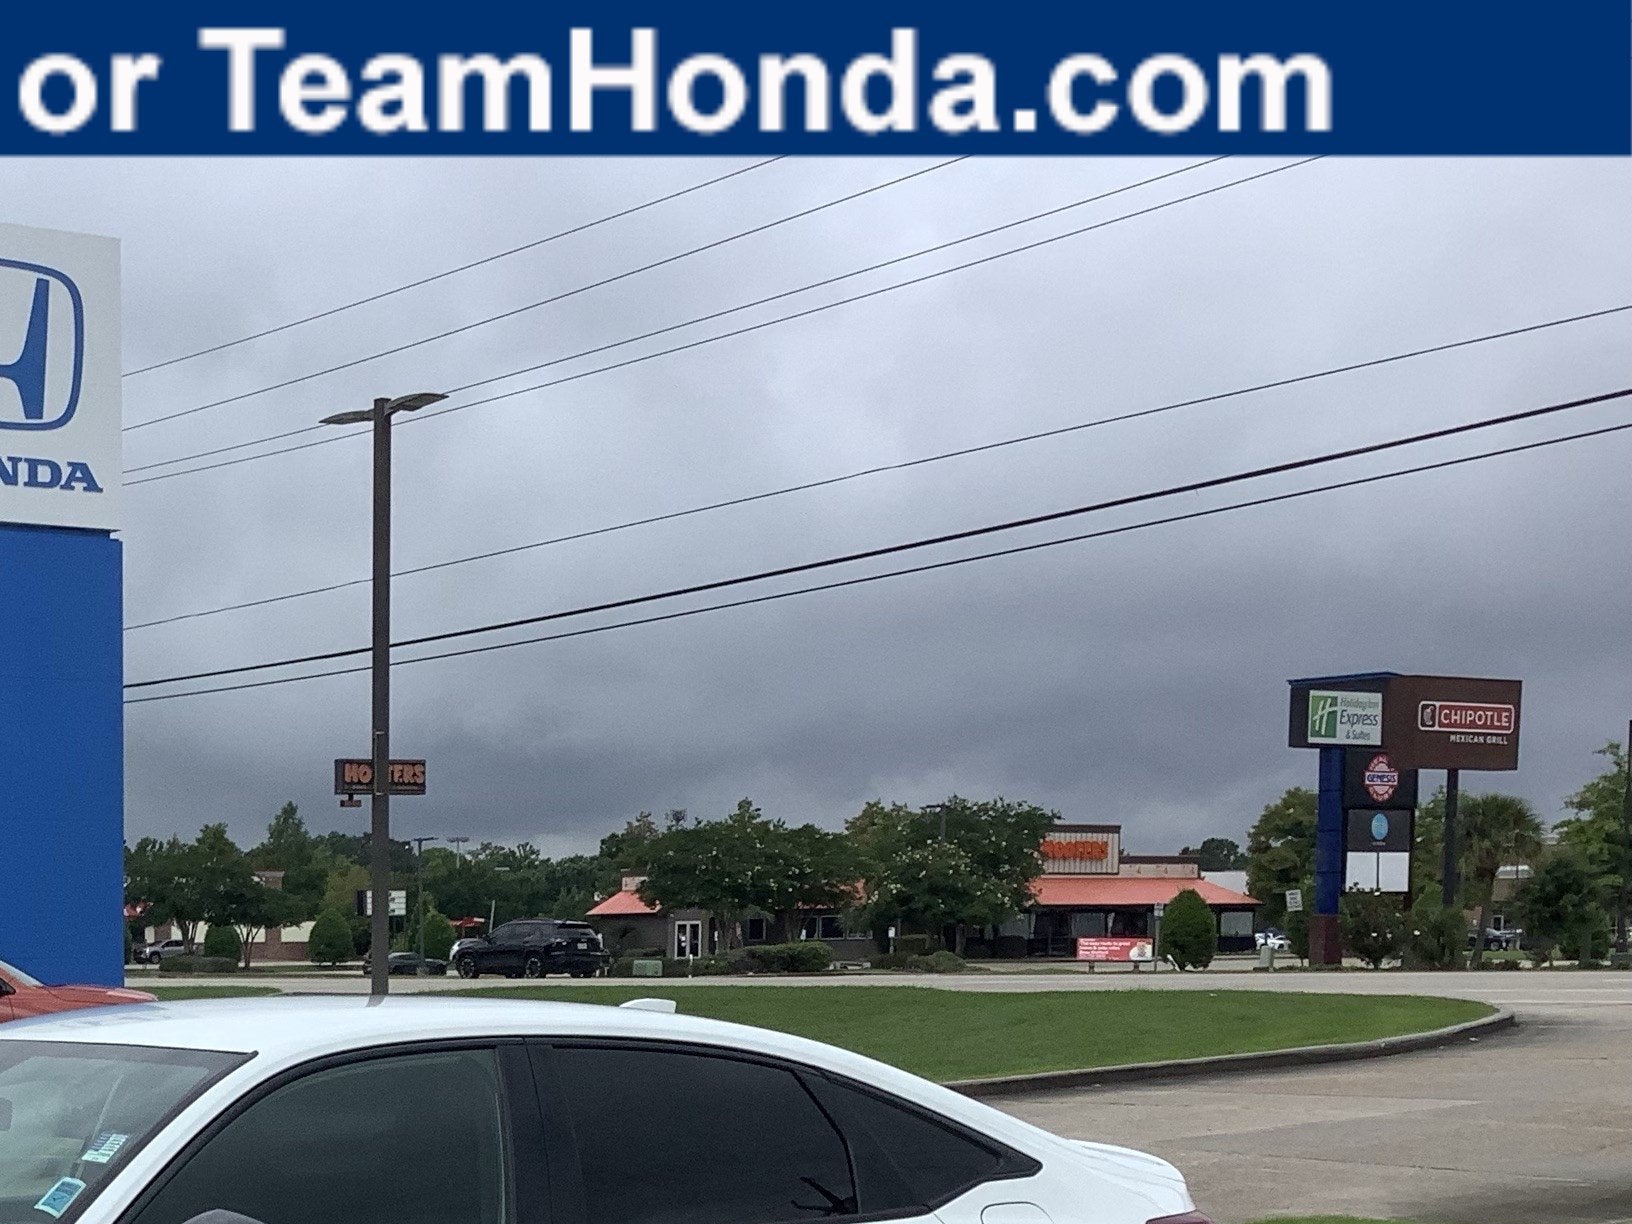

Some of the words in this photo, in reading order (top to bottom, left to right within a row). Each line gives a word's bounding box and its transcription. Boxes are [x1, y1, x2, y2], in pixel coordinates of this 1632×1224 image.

[1340, 709, 1378, 727] Express
[1440, 709, 1510, 727] CHIPOTLE
[1449, 734, 1485, 744] MEXICAN
[1486, 736, 1508, 745] GRILL
[344, 763, 424, 784] HOTERS
